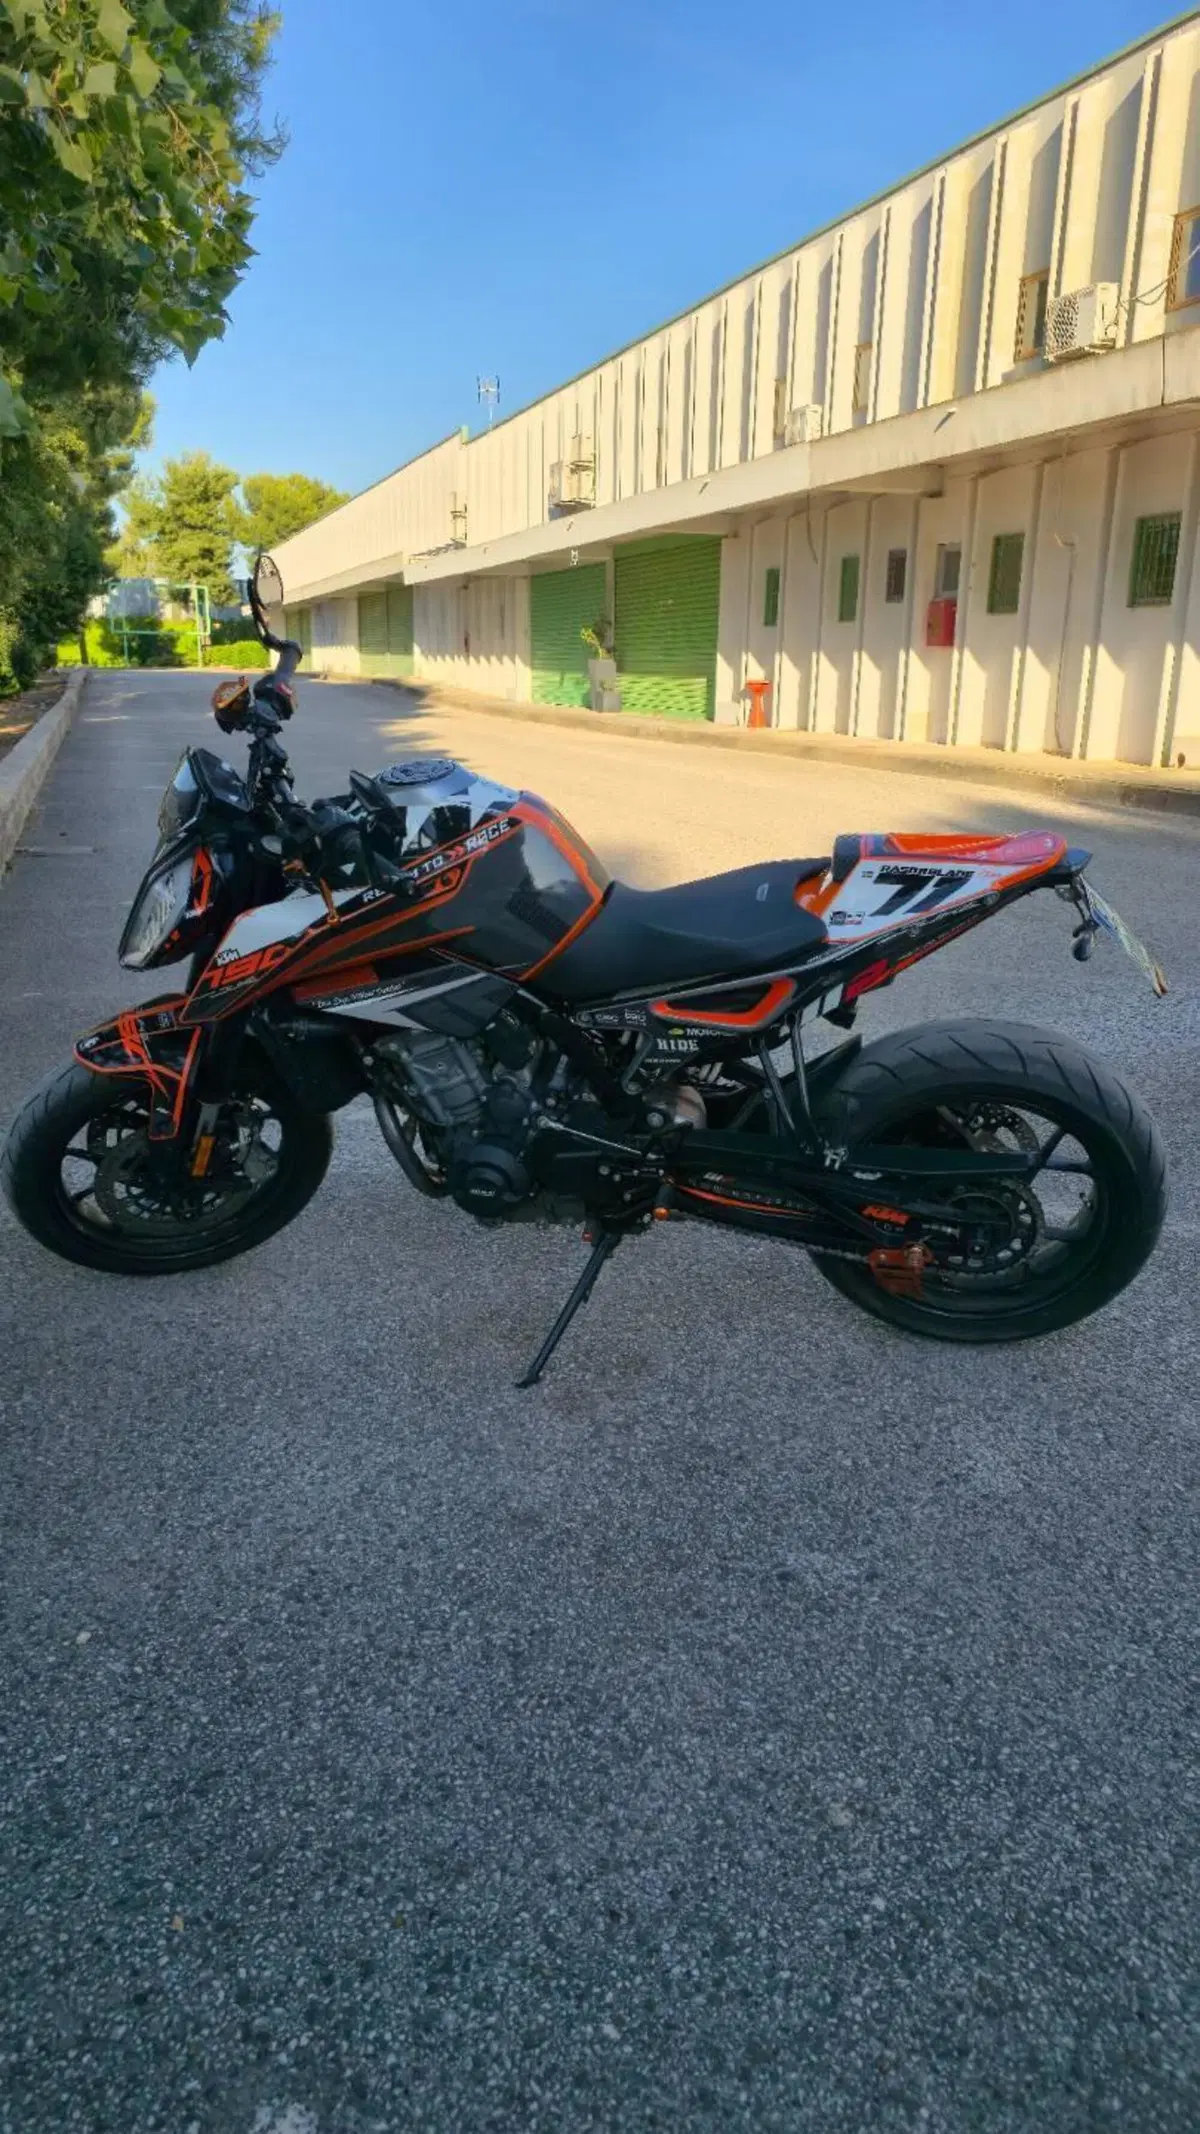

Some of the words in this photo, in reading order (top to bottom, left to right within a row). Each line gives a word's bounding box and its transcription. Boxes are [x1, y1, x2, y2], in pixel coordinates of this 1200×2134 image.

[424, 854, 444, 874] TO
[465, 817, 511, 850] RACE
[203, 943, 291, 989] 790
[215, 947, 240, 967] KTM
